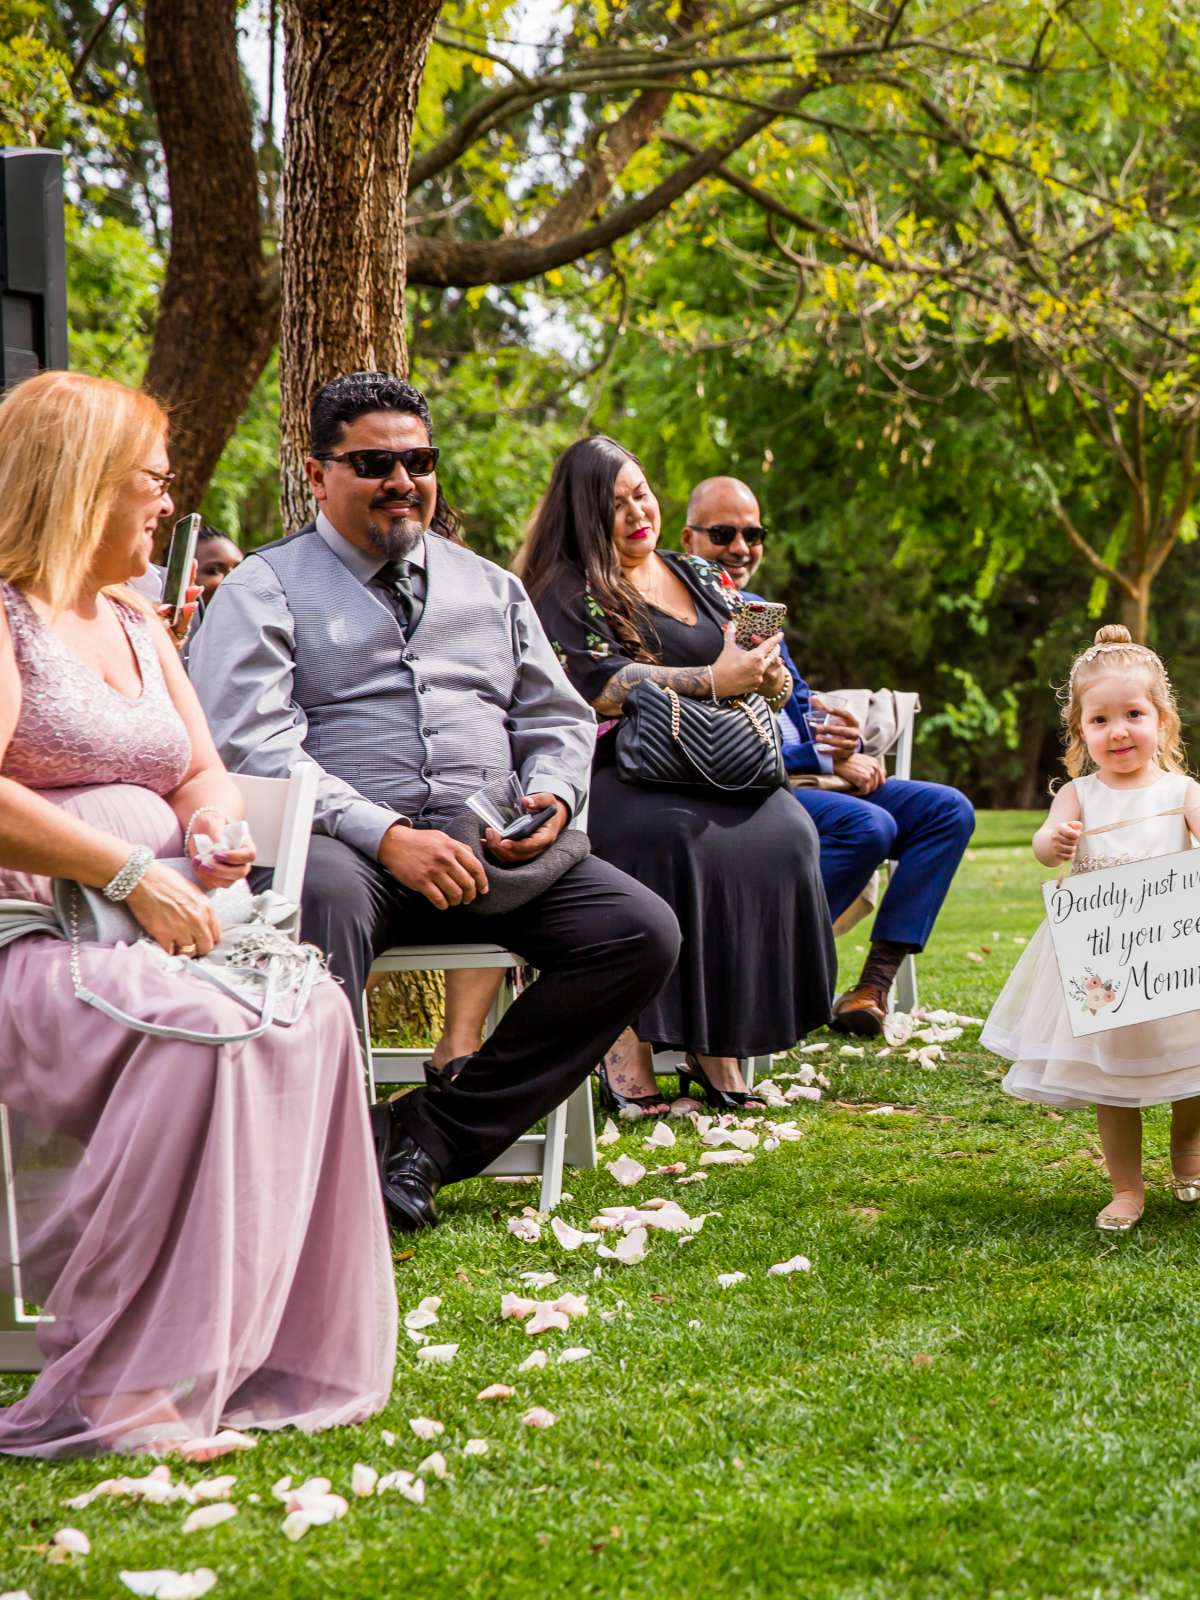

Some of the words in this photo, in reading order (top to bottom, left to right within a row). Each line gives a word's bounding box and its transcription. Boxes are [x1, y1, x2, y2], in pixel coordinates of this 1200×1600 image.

[1051, 882, 1134, 924] Daddy,
[1133, 868, 1178, 914] just
[1120, 925, 1163, 966] you
